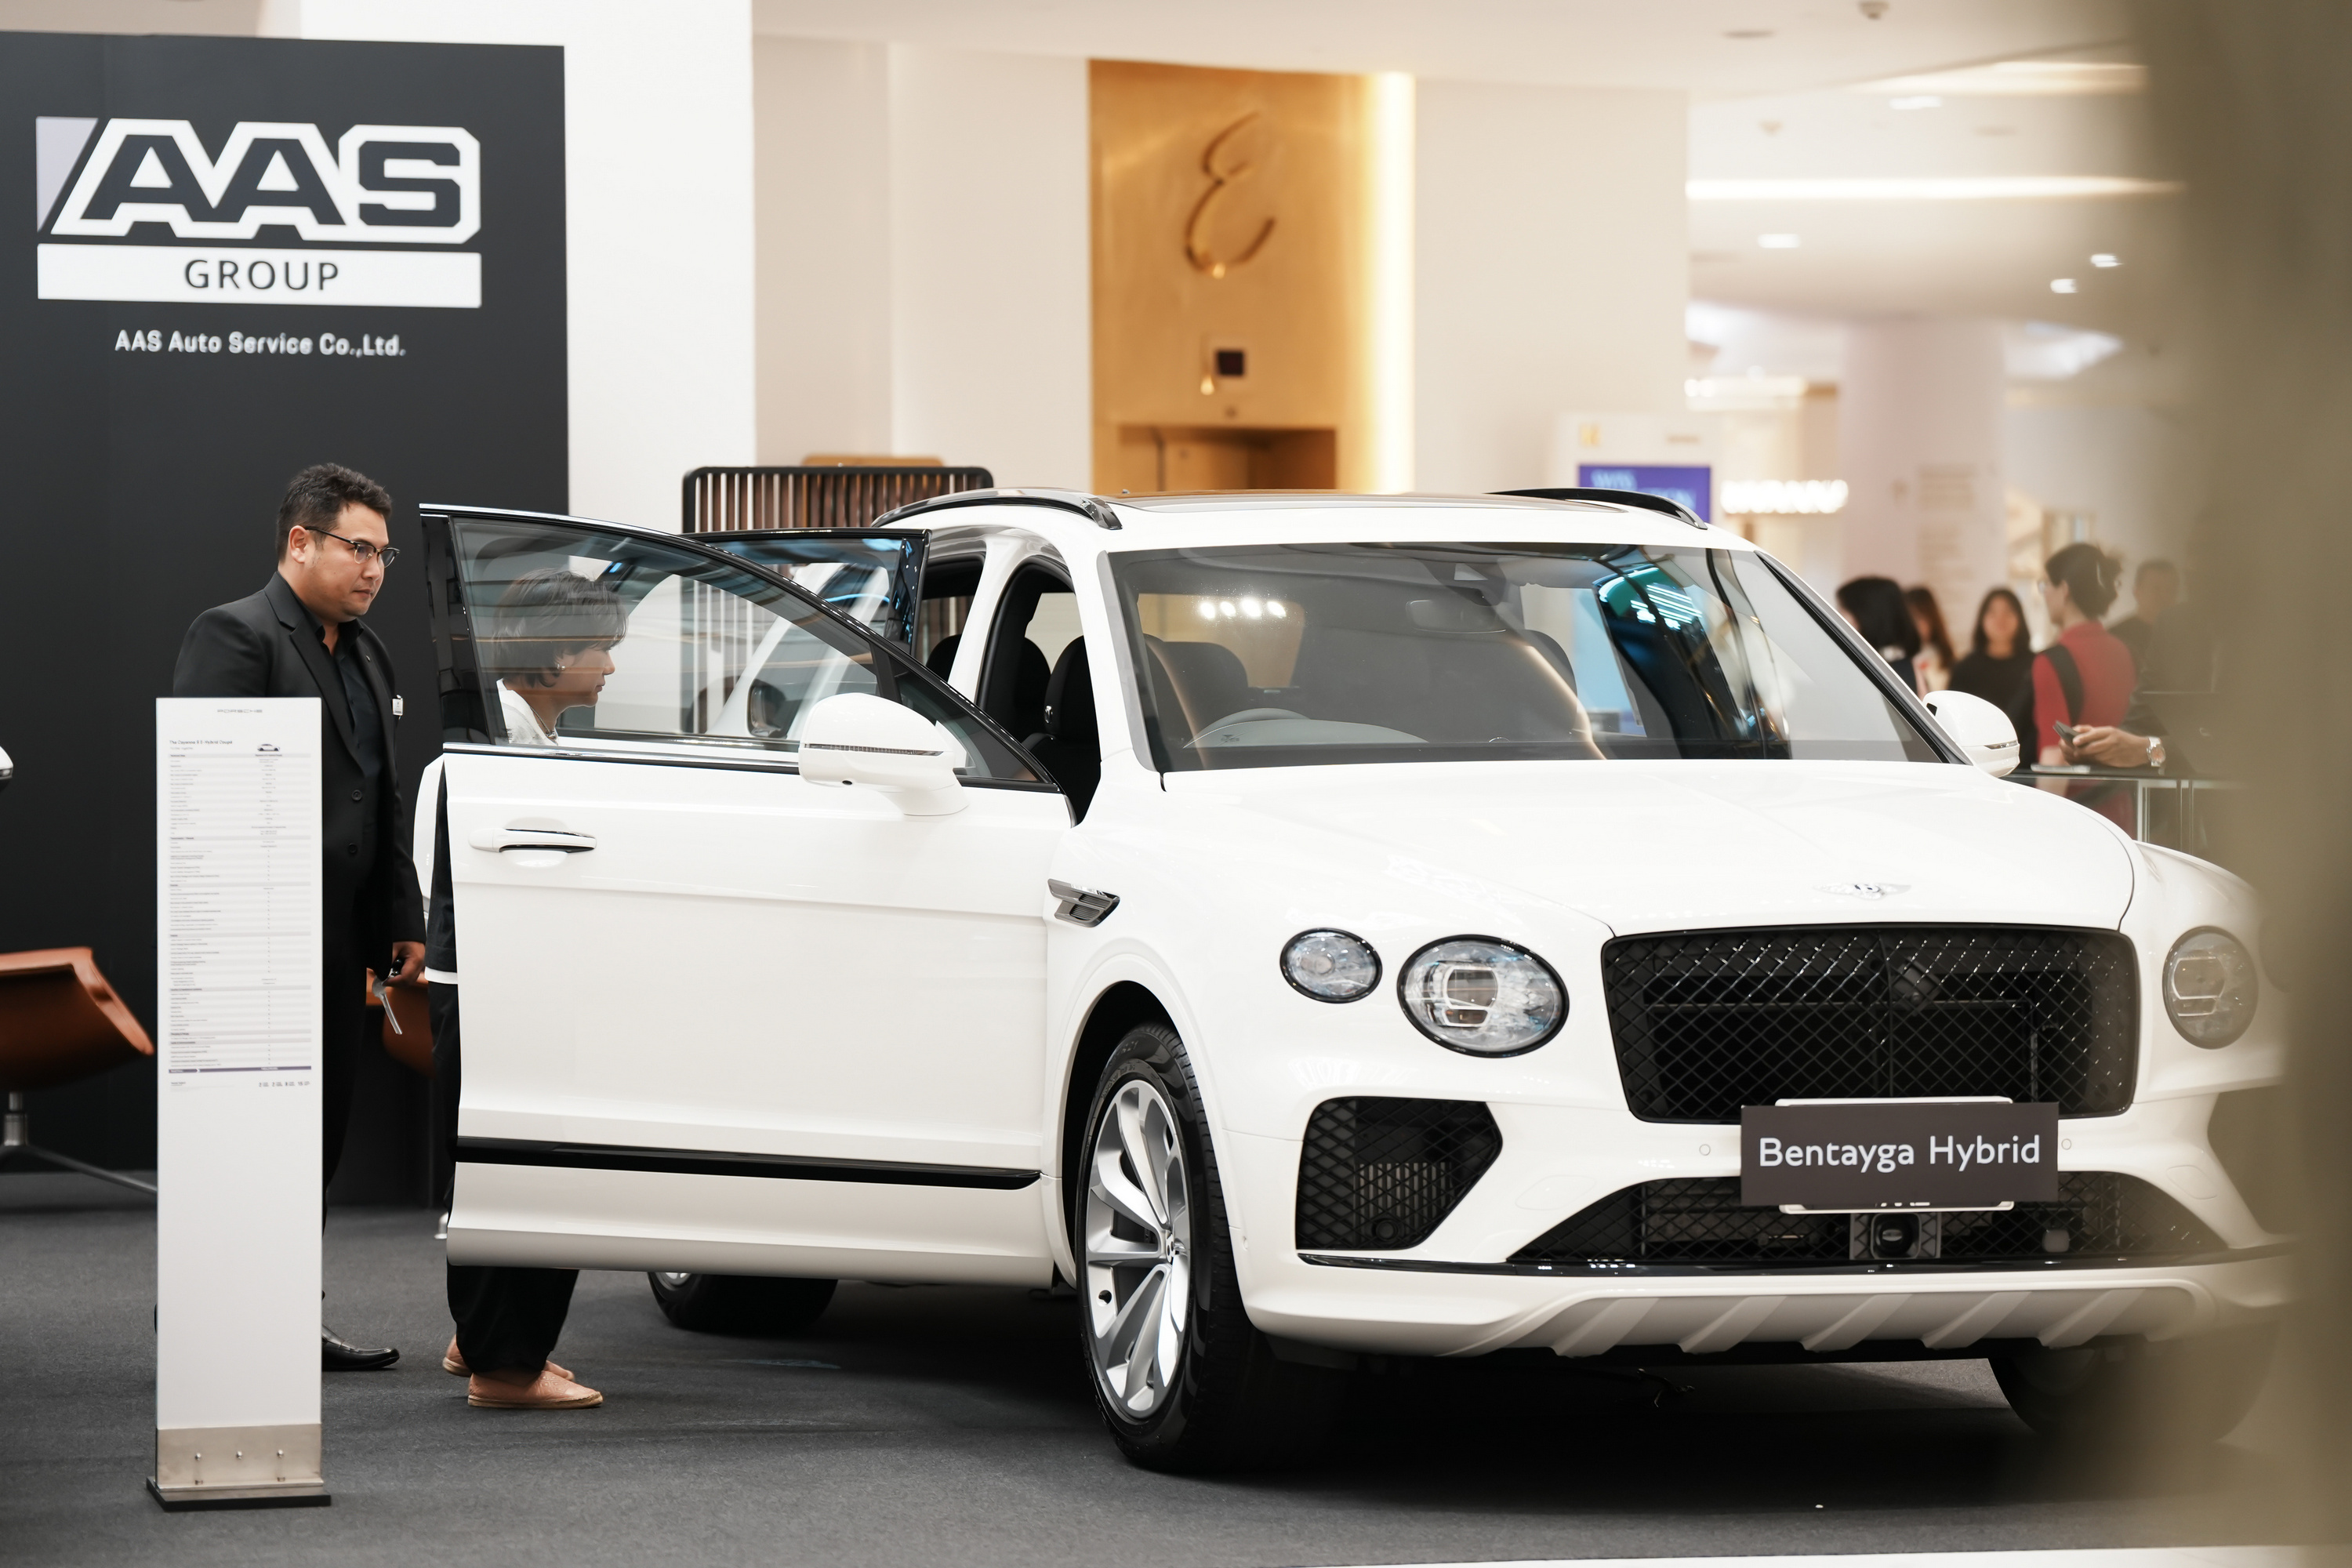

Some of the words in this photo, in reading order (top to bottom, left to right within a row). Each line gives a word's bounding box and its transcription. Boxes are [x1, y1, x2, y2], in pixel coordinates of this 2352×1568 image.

[75, 132, 464, 230] AAS
[184, 260, 339, 291] GROUP
[114, 329, 163, 353] AAS
[168, 330, 223, 354] Auto
[228, 331, 314, 355] Service
[318, 332, 406, 358] Co.,Ltd.
[1759, 1137, 1915, 1174] Bentayga
[1929, 1134, 2040, 1173] Hybrid
